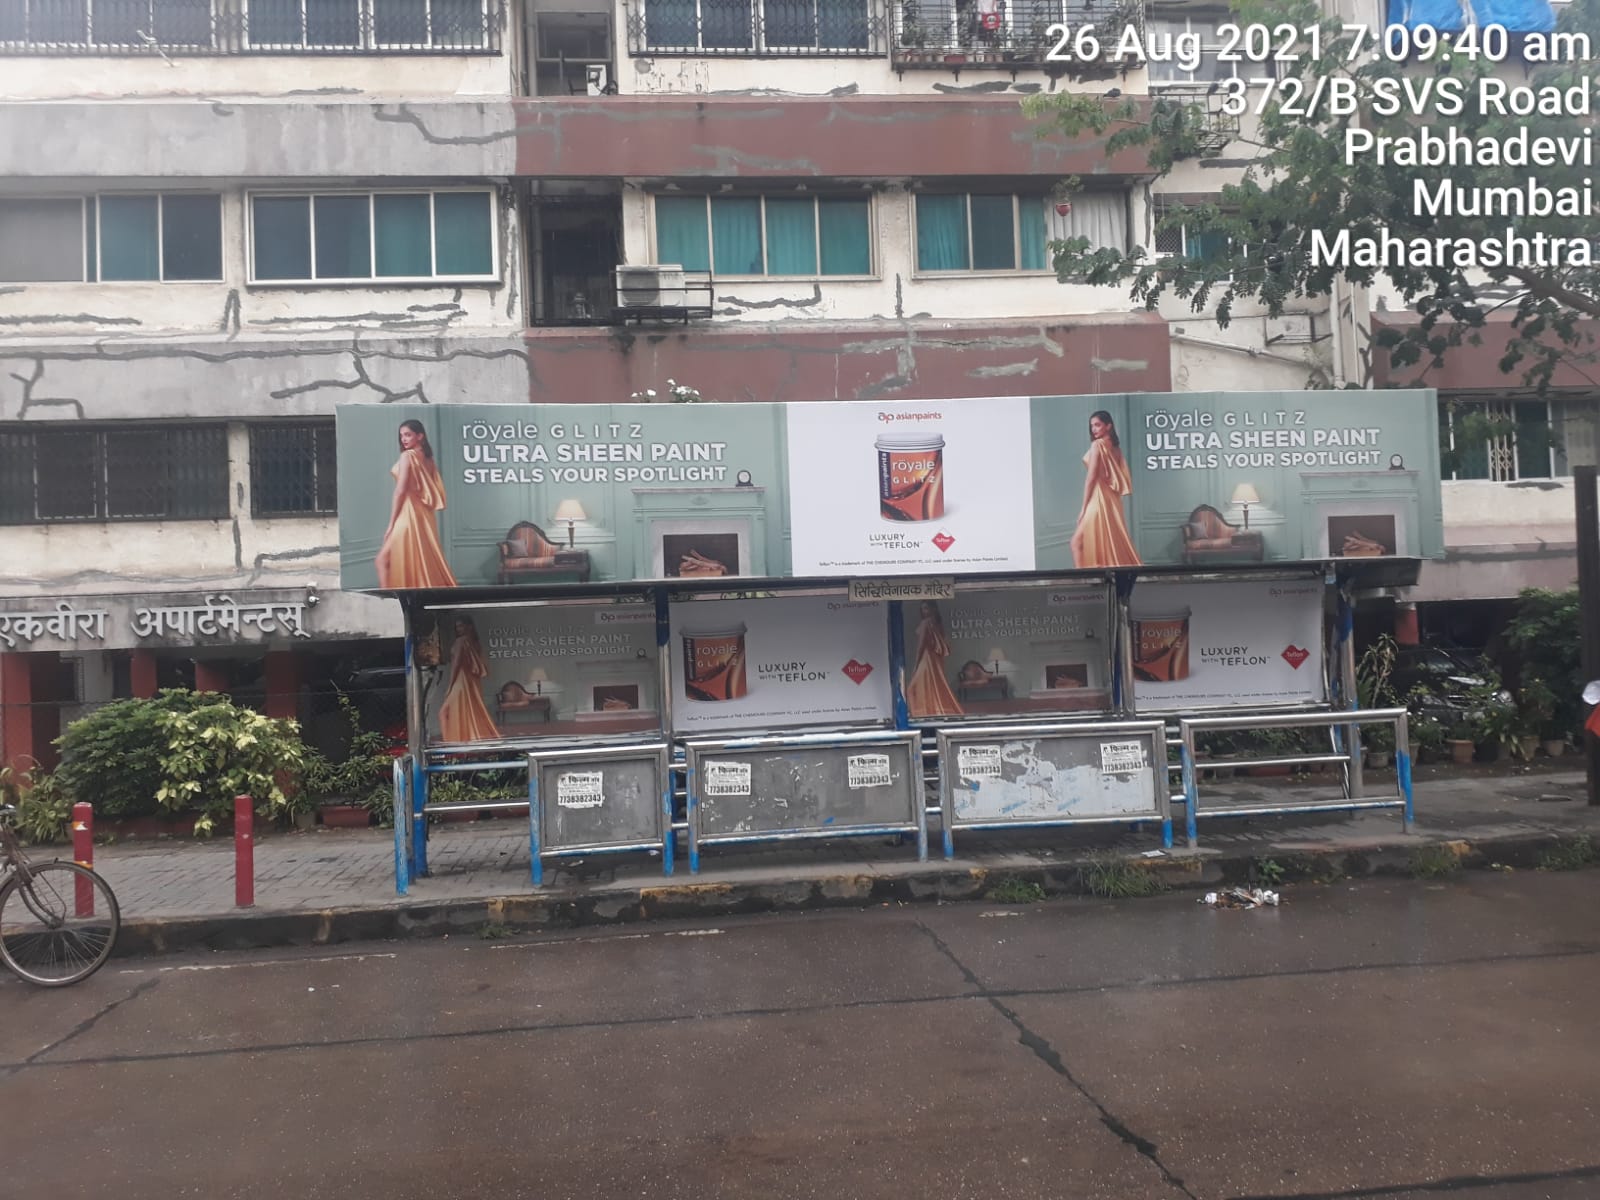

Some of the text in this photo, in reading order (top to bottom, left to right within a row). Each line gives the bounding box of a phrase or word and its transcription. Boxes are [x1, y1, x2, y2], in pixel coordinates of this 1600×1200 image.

[896, 412, 942, 422] asianpaints
[1146, 428, 1380, 451] ULTRA SHEEN PAINT
[463, 442, 726, 463] ULTRA SHEEN PAINT
[1146, 450, 1381, 470] STEALS YOUR SPOTLIGHT
[463, 465, 727, 484] STEALS YOUR SPOTLIGHT
[869, 533, 906, 542] LUXURY
[951, 619, 993, 630] ULTRA
[997, 617, 1040, 628] SHEEN
[489, 633, 632, 648] ULTRA SHEEN PAINT
[489, 645, 632, 660] STEALS YOUR SPOTLIGHT
[1200, 646, 1249, 656] LUXURY
[758, 661, 807, 673] LUXURY
